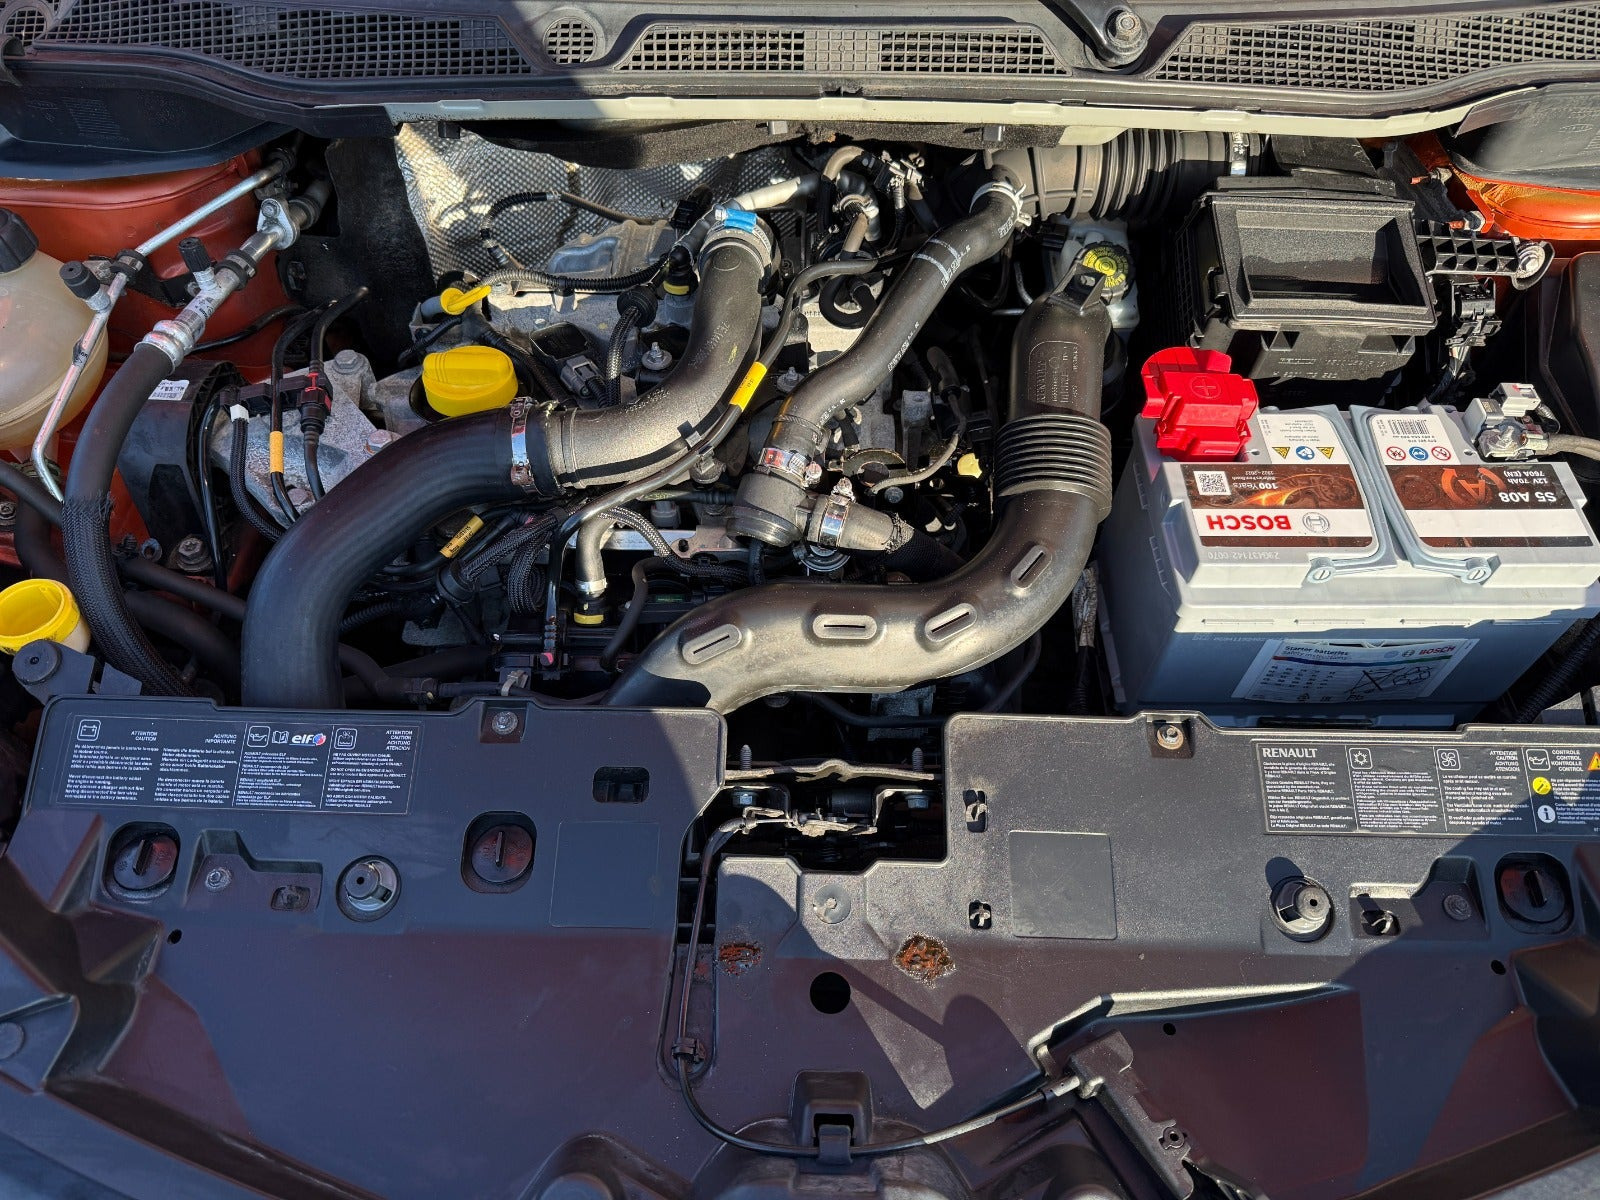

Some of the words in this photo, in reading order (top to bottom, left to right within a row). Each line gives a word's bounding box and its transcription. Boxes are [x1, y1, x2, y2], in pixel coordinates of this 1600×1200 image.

[1498, 492, 1530, 502] A08
[1534, 492, 1557, 502] S5
[1206, 514, 1292, 530] BOSCH
[1419, 646, 1456, 655] BOSCH
[291, 734, 314, 744] elf
[1261, 748, 1318, 758] RENAULT
